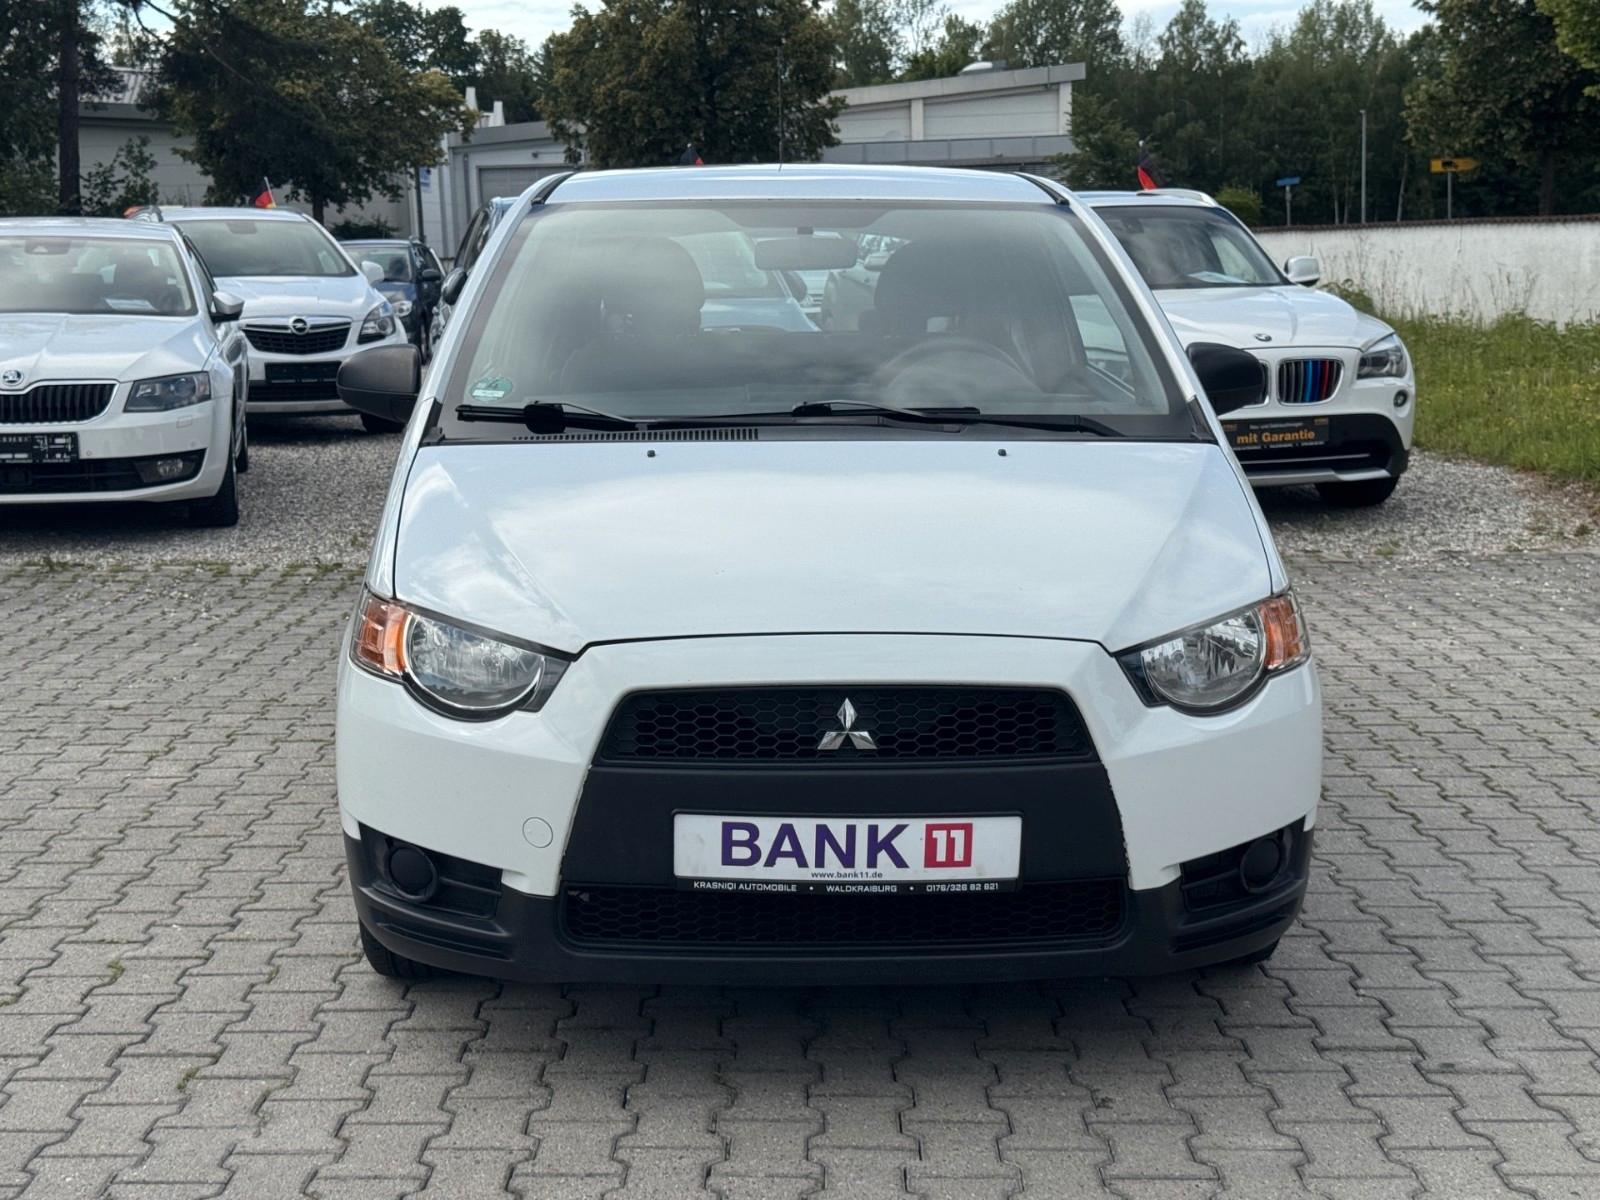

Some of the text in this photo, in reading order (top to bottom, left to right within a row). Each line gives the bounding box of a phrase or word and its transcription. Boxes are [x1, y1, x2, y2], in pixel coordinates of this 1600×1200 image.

[1236, 429, 1316, 444] mit Garantie
[721, 821, 966, 869] BANK 11
[811, 871, 883, 879] www.bank11.de
[693, 881, 736, 891] KRASNIQI
[738, 882, 797, 892] AUTOMOBILE
[826, 884, 897, 893] WALDKRAIBURG
